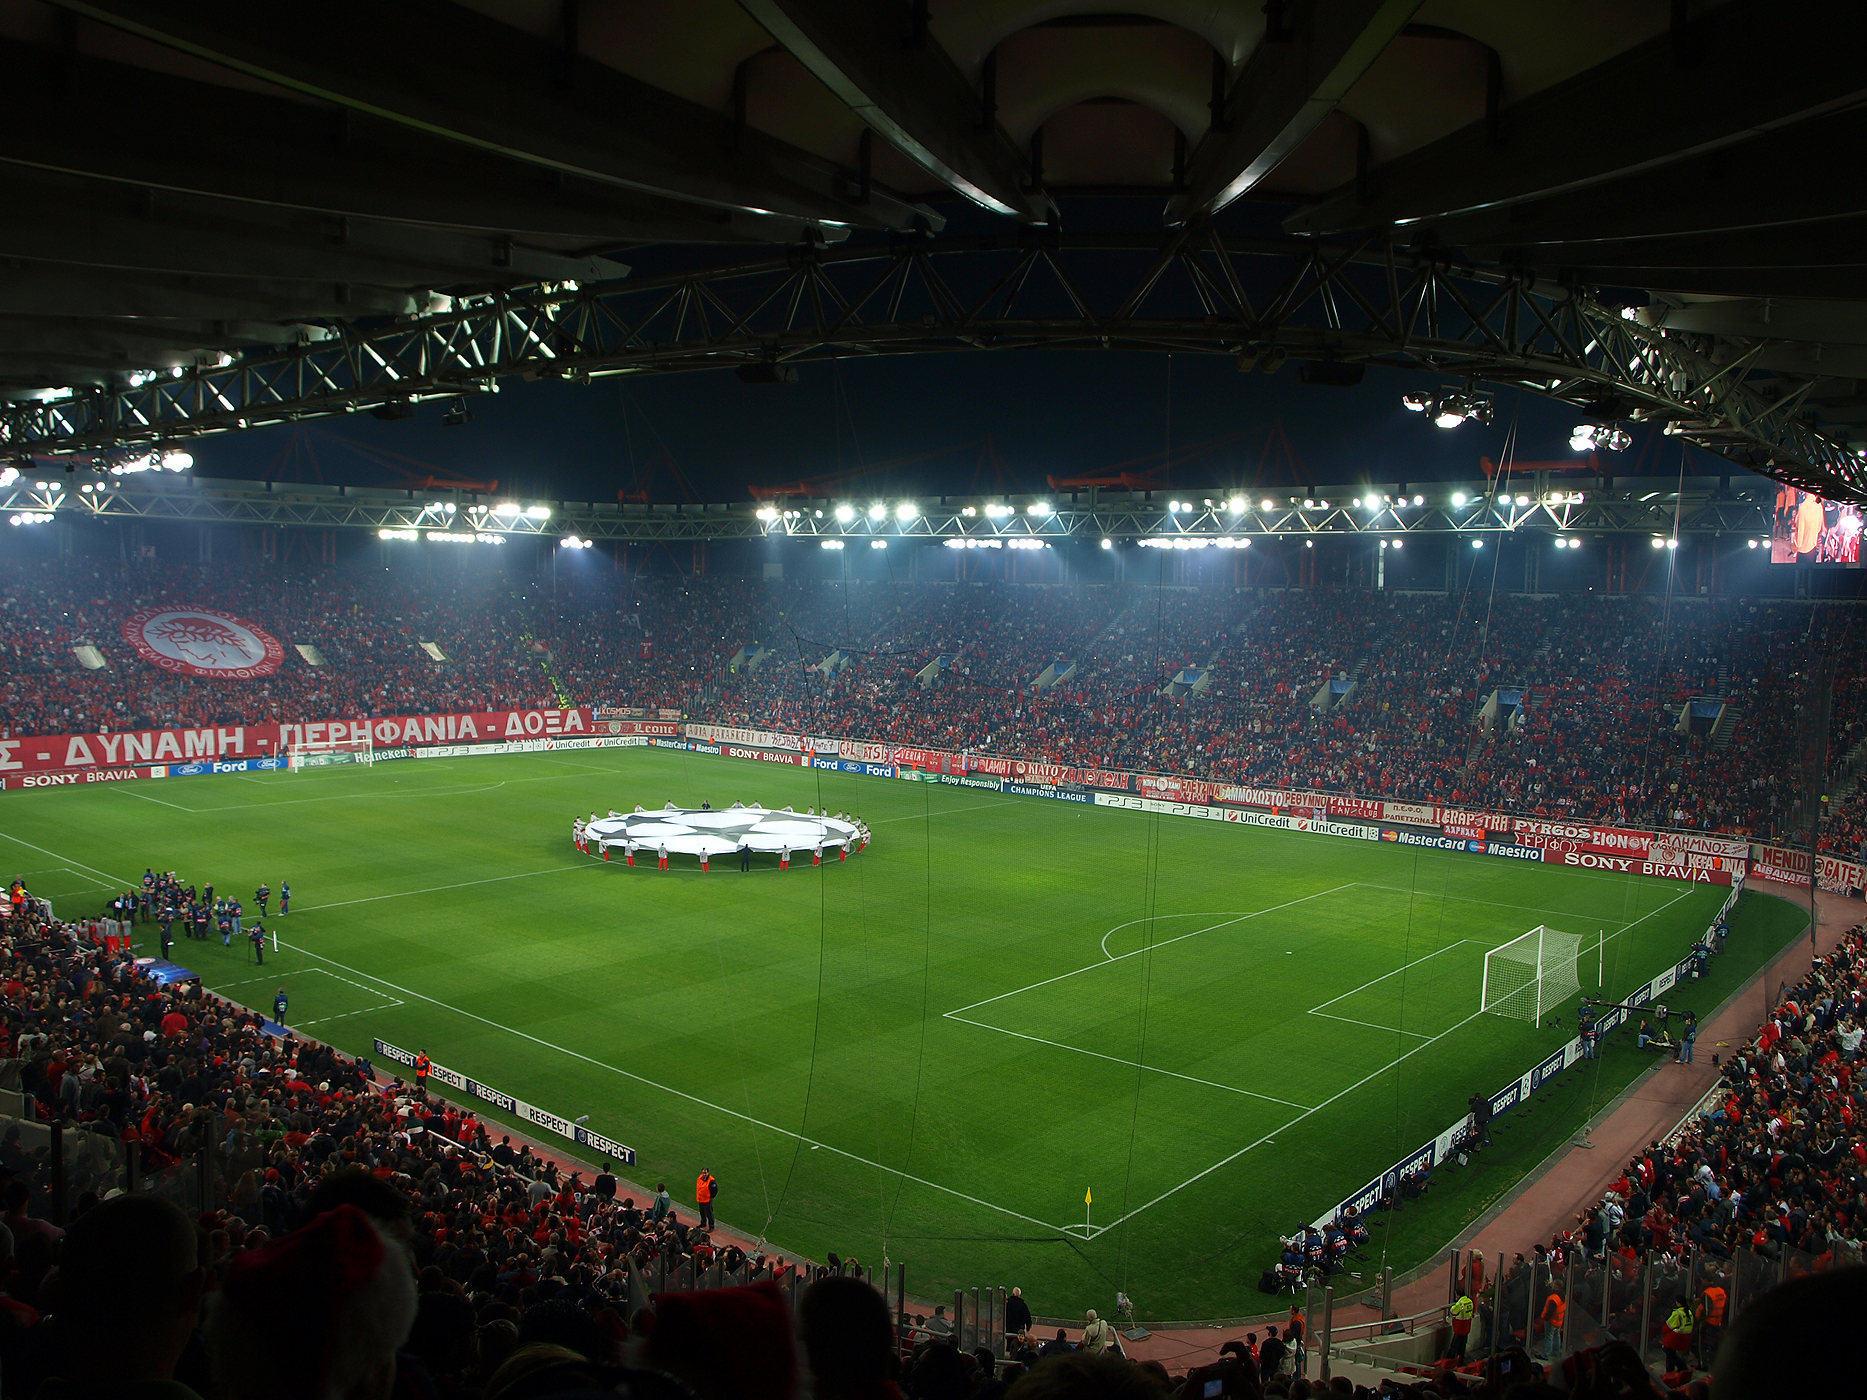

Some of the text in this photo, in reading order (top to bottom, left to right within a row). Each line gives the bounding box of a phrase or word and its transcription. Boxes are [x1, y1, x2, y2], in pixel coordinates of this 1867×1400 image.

[633, 722, 674, 735] Leone
[64, 727, 244, 767] ΔΥΝΑΜΗ
[280, 714, 479, 750] ΠΕΡΗΦΑΝΙΑ
[505, 709, 585, 736] ΔΟΞΑ
[555, 738, 639, 750] UniCredit UniCredit
[656, 739, 687, 750] MasterCard
[353, 748, 408, 763] Heineken
[696, 744, 719, 755] Maestro
[729, 748, 794, 764] SONY BRAVIA
[212, 760, 248, 773] Ford
[814, 758, 838, 770] Ford
[866, 764, 892, 777] Ford
[985, 759, 1006, 775] LAMIA
[1028, 763, 1069, 779] KIATO 7
[22, 773, 80, 788] SONY
[86, 769, 138, 783] BRAVIA
[941, 775, 960, 786] Enjoy
[960, 777, 1000, 791] Responsibly
[1040, 783, 1057, 791] UEFA
[1010, 785, 1087, 802] CHAMPIONS LEAGUE
[1225, 786, 1288, 807] ΑΜΜΟΧΩΣΤΟ
[1108, 795, 1143, 809] PS3
[1172, 803, 1209, 818] PS3
[1241, 812, 1364, 838] UniCredit UniCredit
[1383, 813, 1434, 825] ΡΑΠΕΤΣΩΝΑΣ
[1514, 819, 1592, 839] PYRGOS
[1398, 831, 1467, 851] MasterCard
[1488, 843, 1540, 860] Maestro
[1564, 852, 1711, 884] SONY BRAVIA
[383, 1043, 415, 1067] RESPECT
[431, 1063, 462, 1088] ESPECT
[1542, 1055, 1563, 1080] RESPECT
[476, 1081, 513, 1111] RESPECT
[1492, 1087, 1518, 1116] RESPECT
[529, 1108, 569, 1135] RESPECT
[587, 1133, 632, 1162] RESPECT
